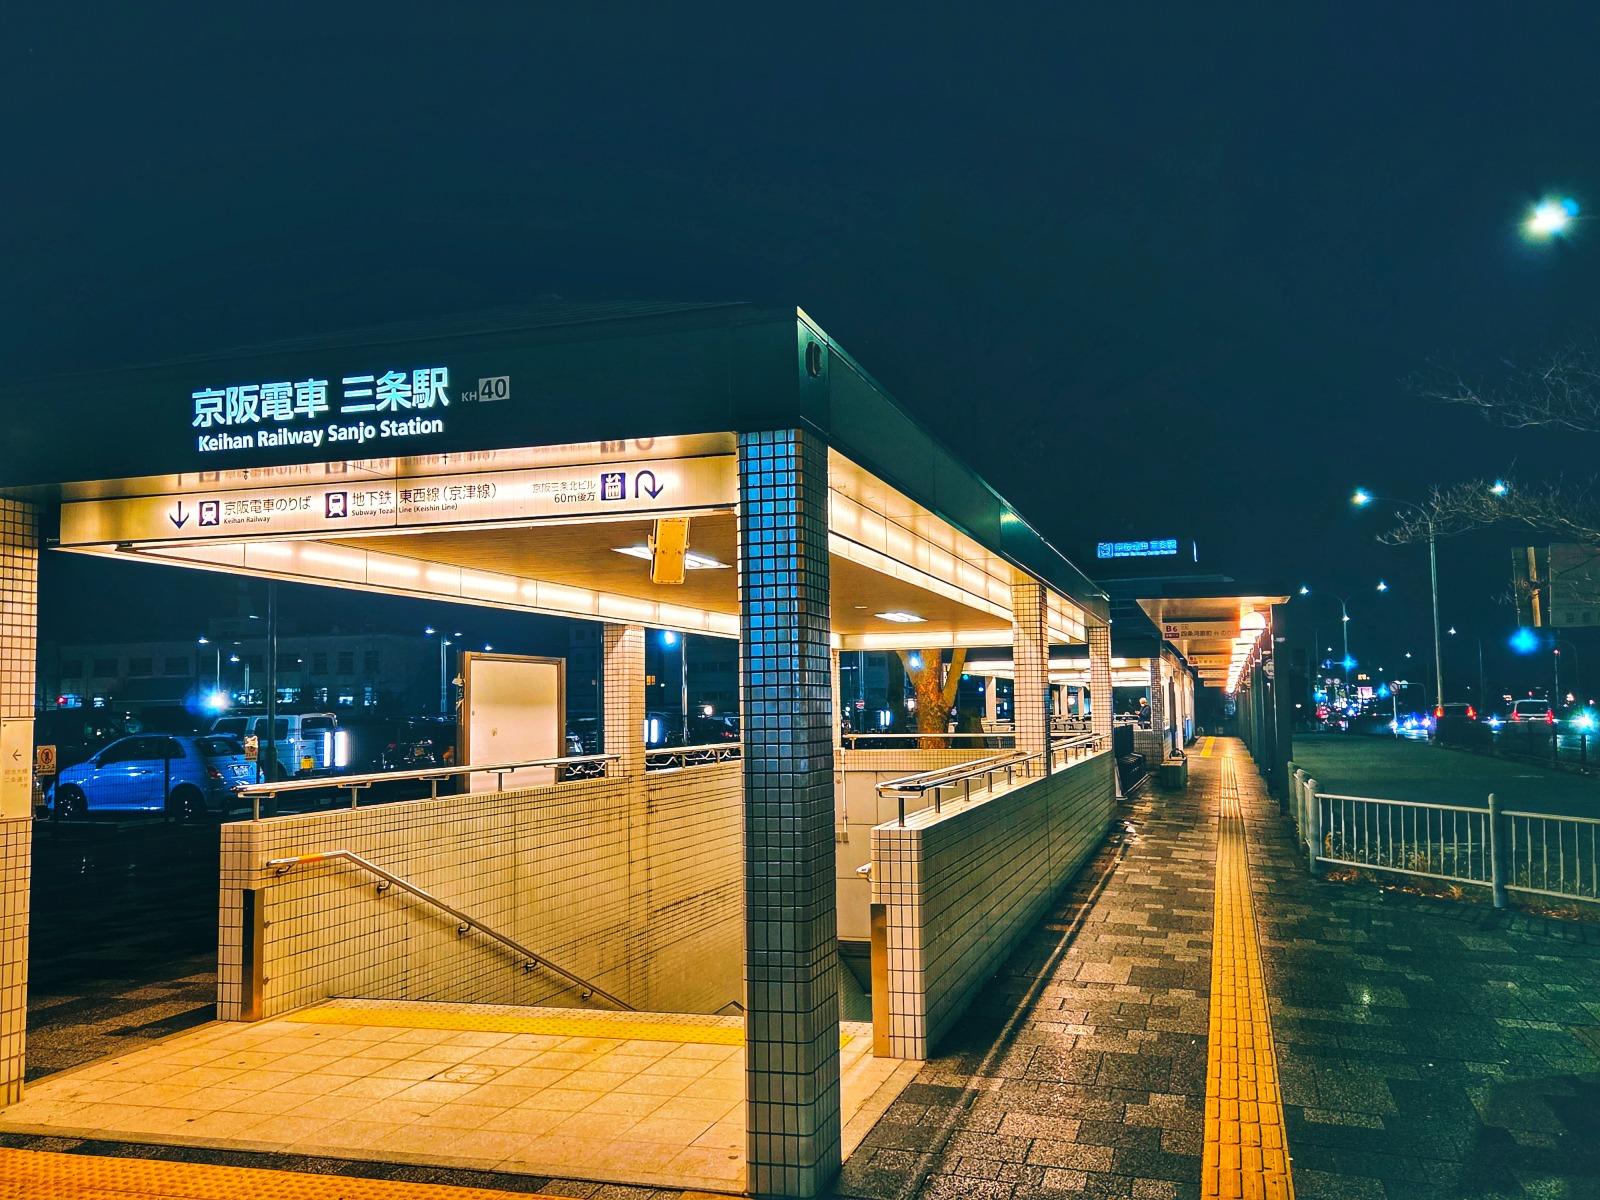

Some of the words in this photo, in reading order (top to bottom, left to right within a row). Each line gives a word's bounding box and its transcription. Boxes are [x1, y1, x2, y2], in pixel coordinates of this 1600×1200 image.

[192, 377, 329, 428] 京阪電車
[340, 366, 450, 414] 三条駅
[461, 391, 478, 402] KH
[480, 377, 507, 400] 40
[198, 432, 254, 452] Keihan
[257, 427, 324, 448] Railway
[328, 422, 376, 444] Sanjo
[380, 417, 444, 438] Station
[224, 495, 312, 515] 京阪電車のりば
[352, 490, 393, 507] 地下鉄
[246, 515, 271, 523] Railway
[351, 509, 377, 517] Subway
[413, 504, 440, 513] (Keishin
[441, 502, 458, 511] Line)
